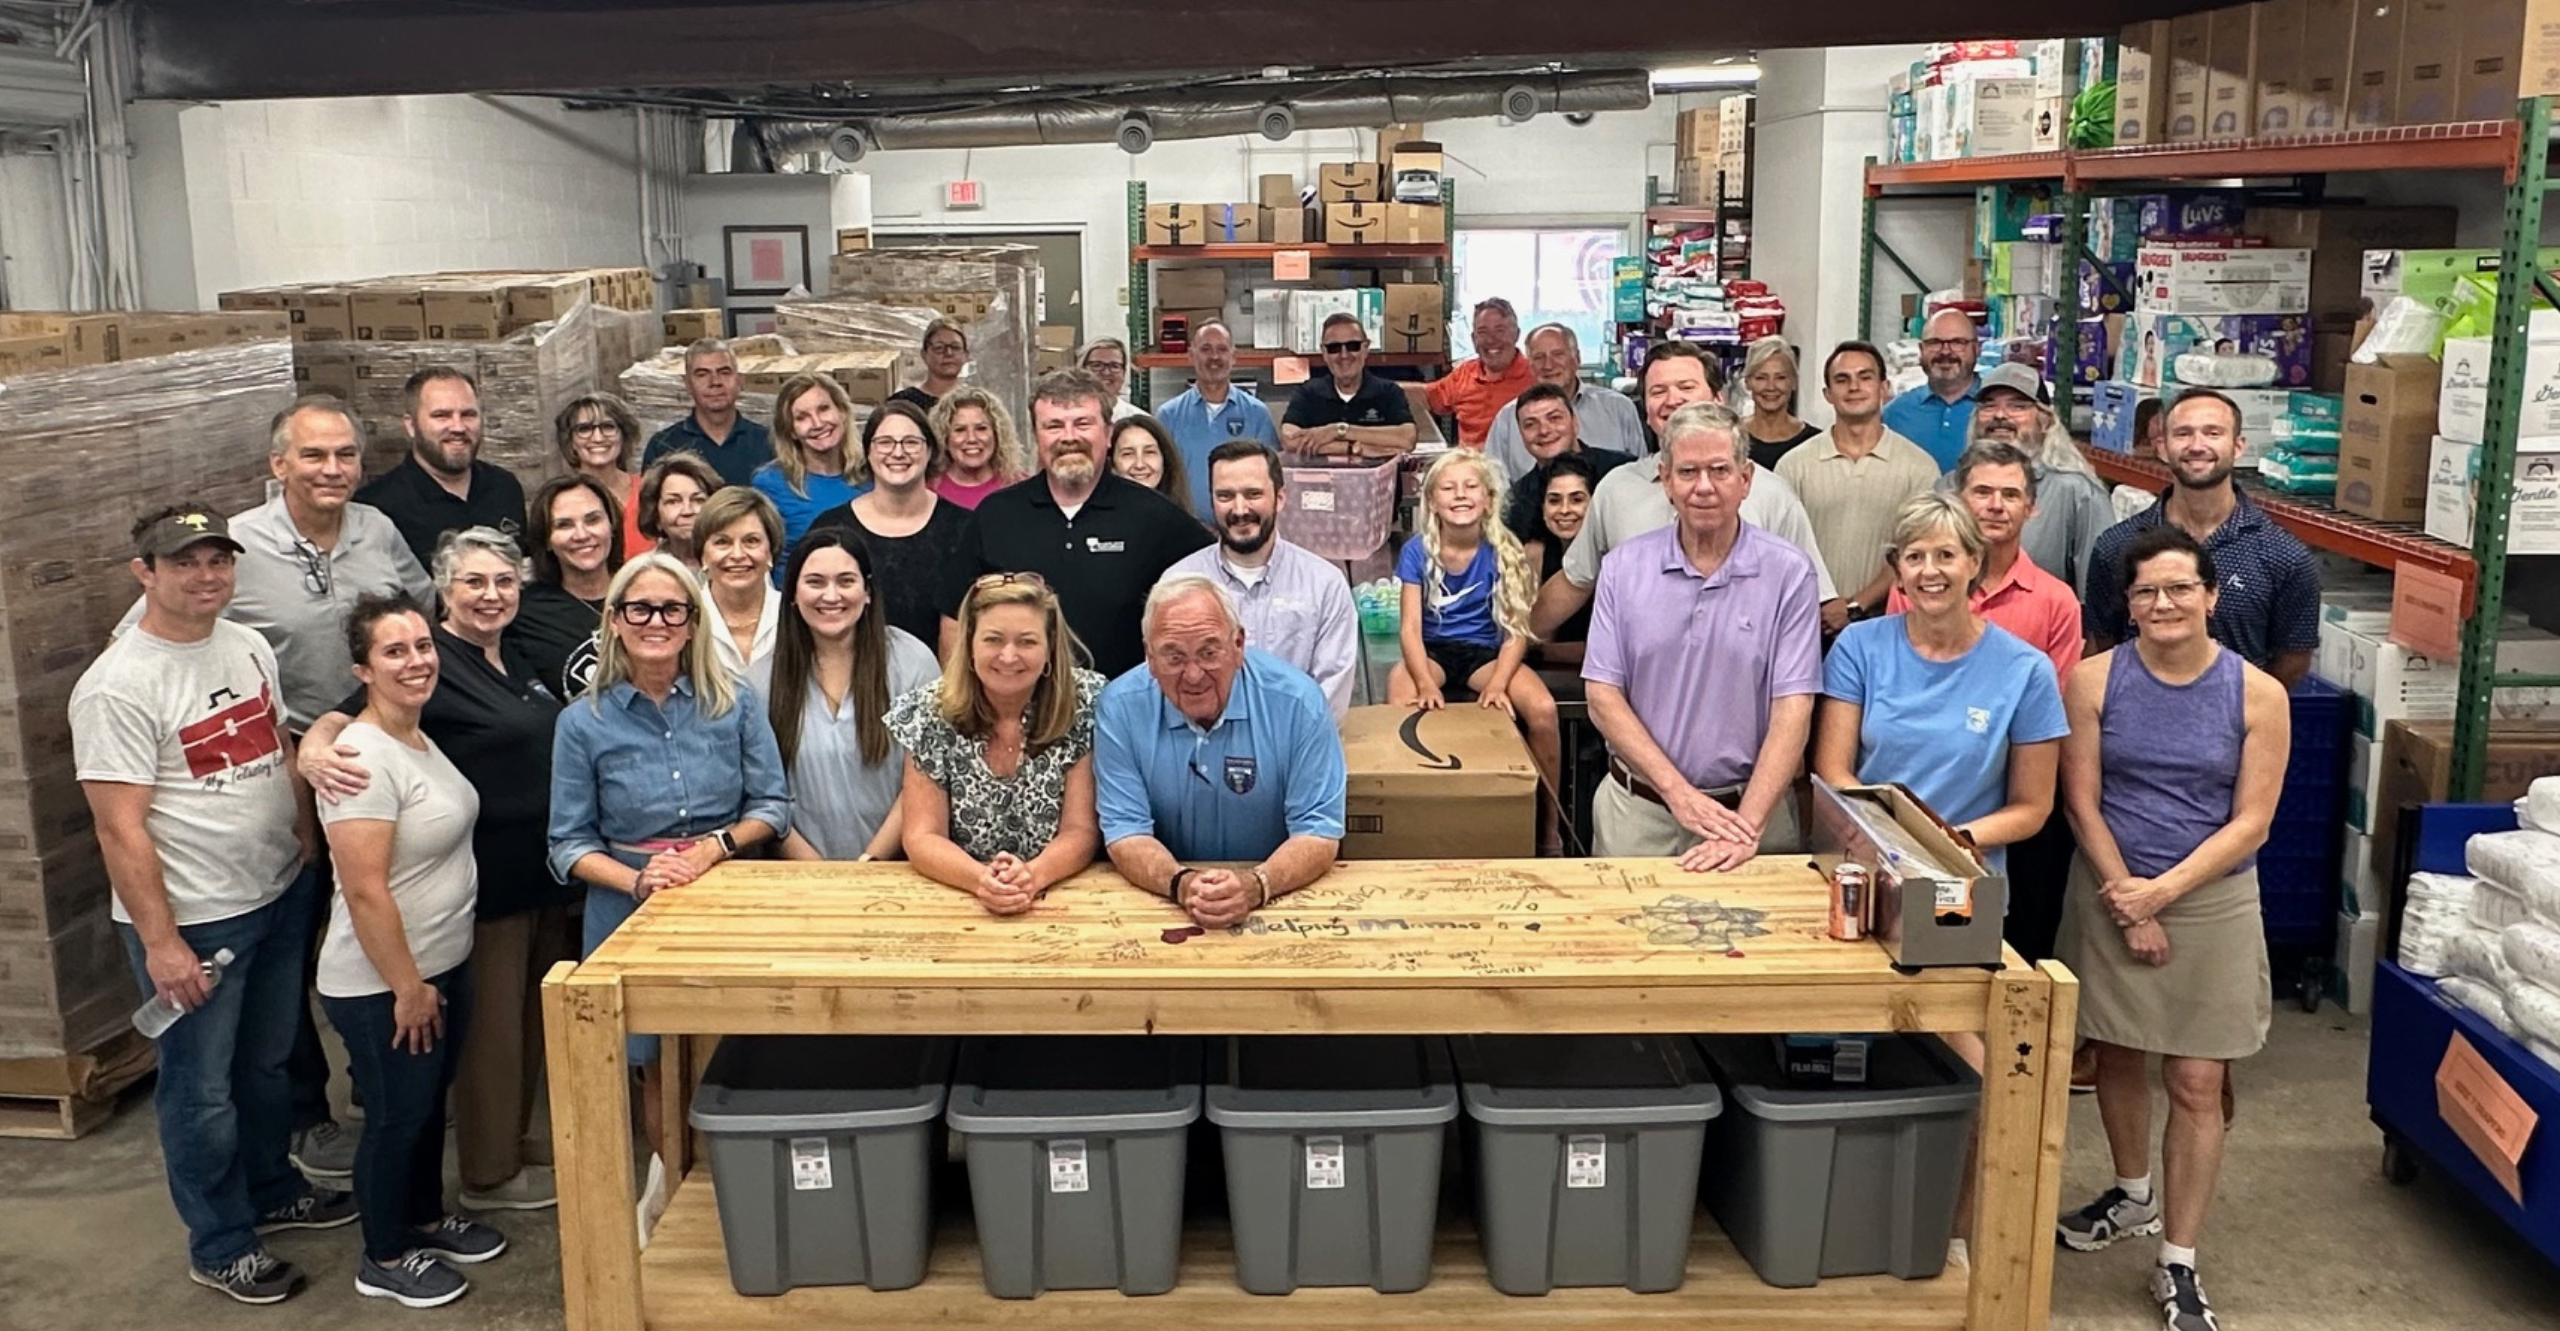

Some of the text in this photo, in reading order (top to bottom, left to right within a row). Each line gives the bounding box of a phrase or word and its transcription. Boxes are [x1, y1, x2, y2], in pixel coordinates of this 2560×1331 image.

[951, 182, 977, 202] EXIT
[2181, 252, 2228, 262] HUGGIES
[1228, 915, 1350, 938] Helping
